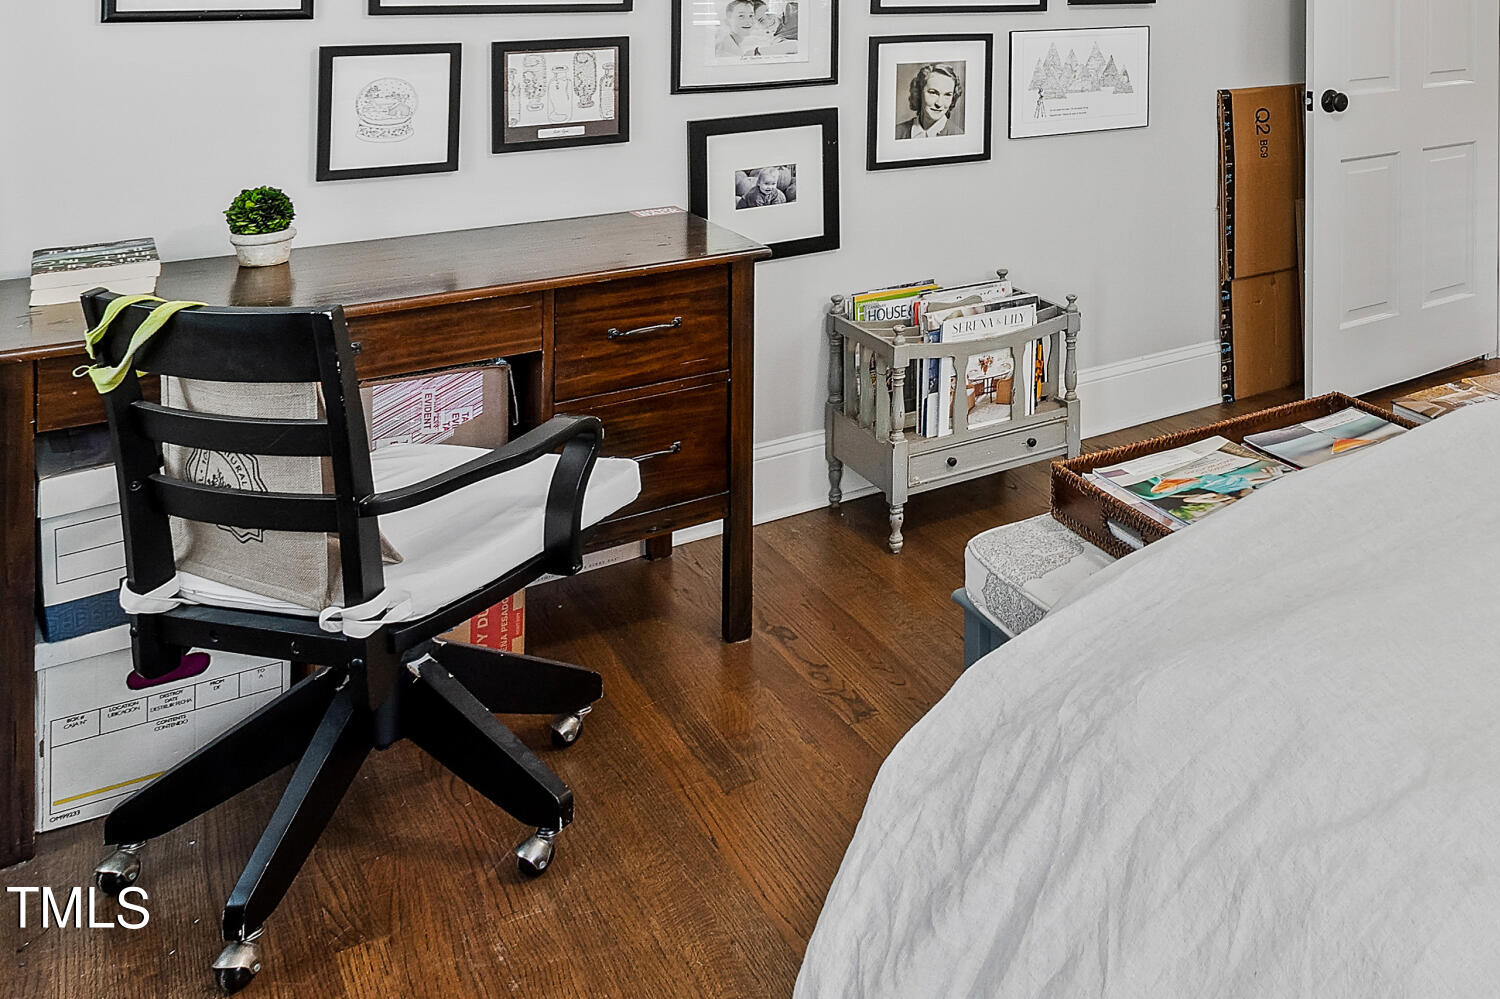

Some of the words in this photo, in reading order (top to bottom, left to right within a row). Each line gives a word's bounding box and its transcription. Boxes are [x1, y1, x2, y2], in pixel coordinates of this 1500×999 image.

[1255, 107, 1271, 136] Q2
[868, 304, 907, 321] HOUSE
[952, 317, 994, 334] SERENA
[424, 392, 432, 429] EVIDENT
[210, 678, 225, 686] FROM
[108, 700, 140, 712] LOCATION
[164, 696, 178, 704] DATE
[66, 715, 80, 723] BOX
[156, 714, 187, 726] CONTENTS
